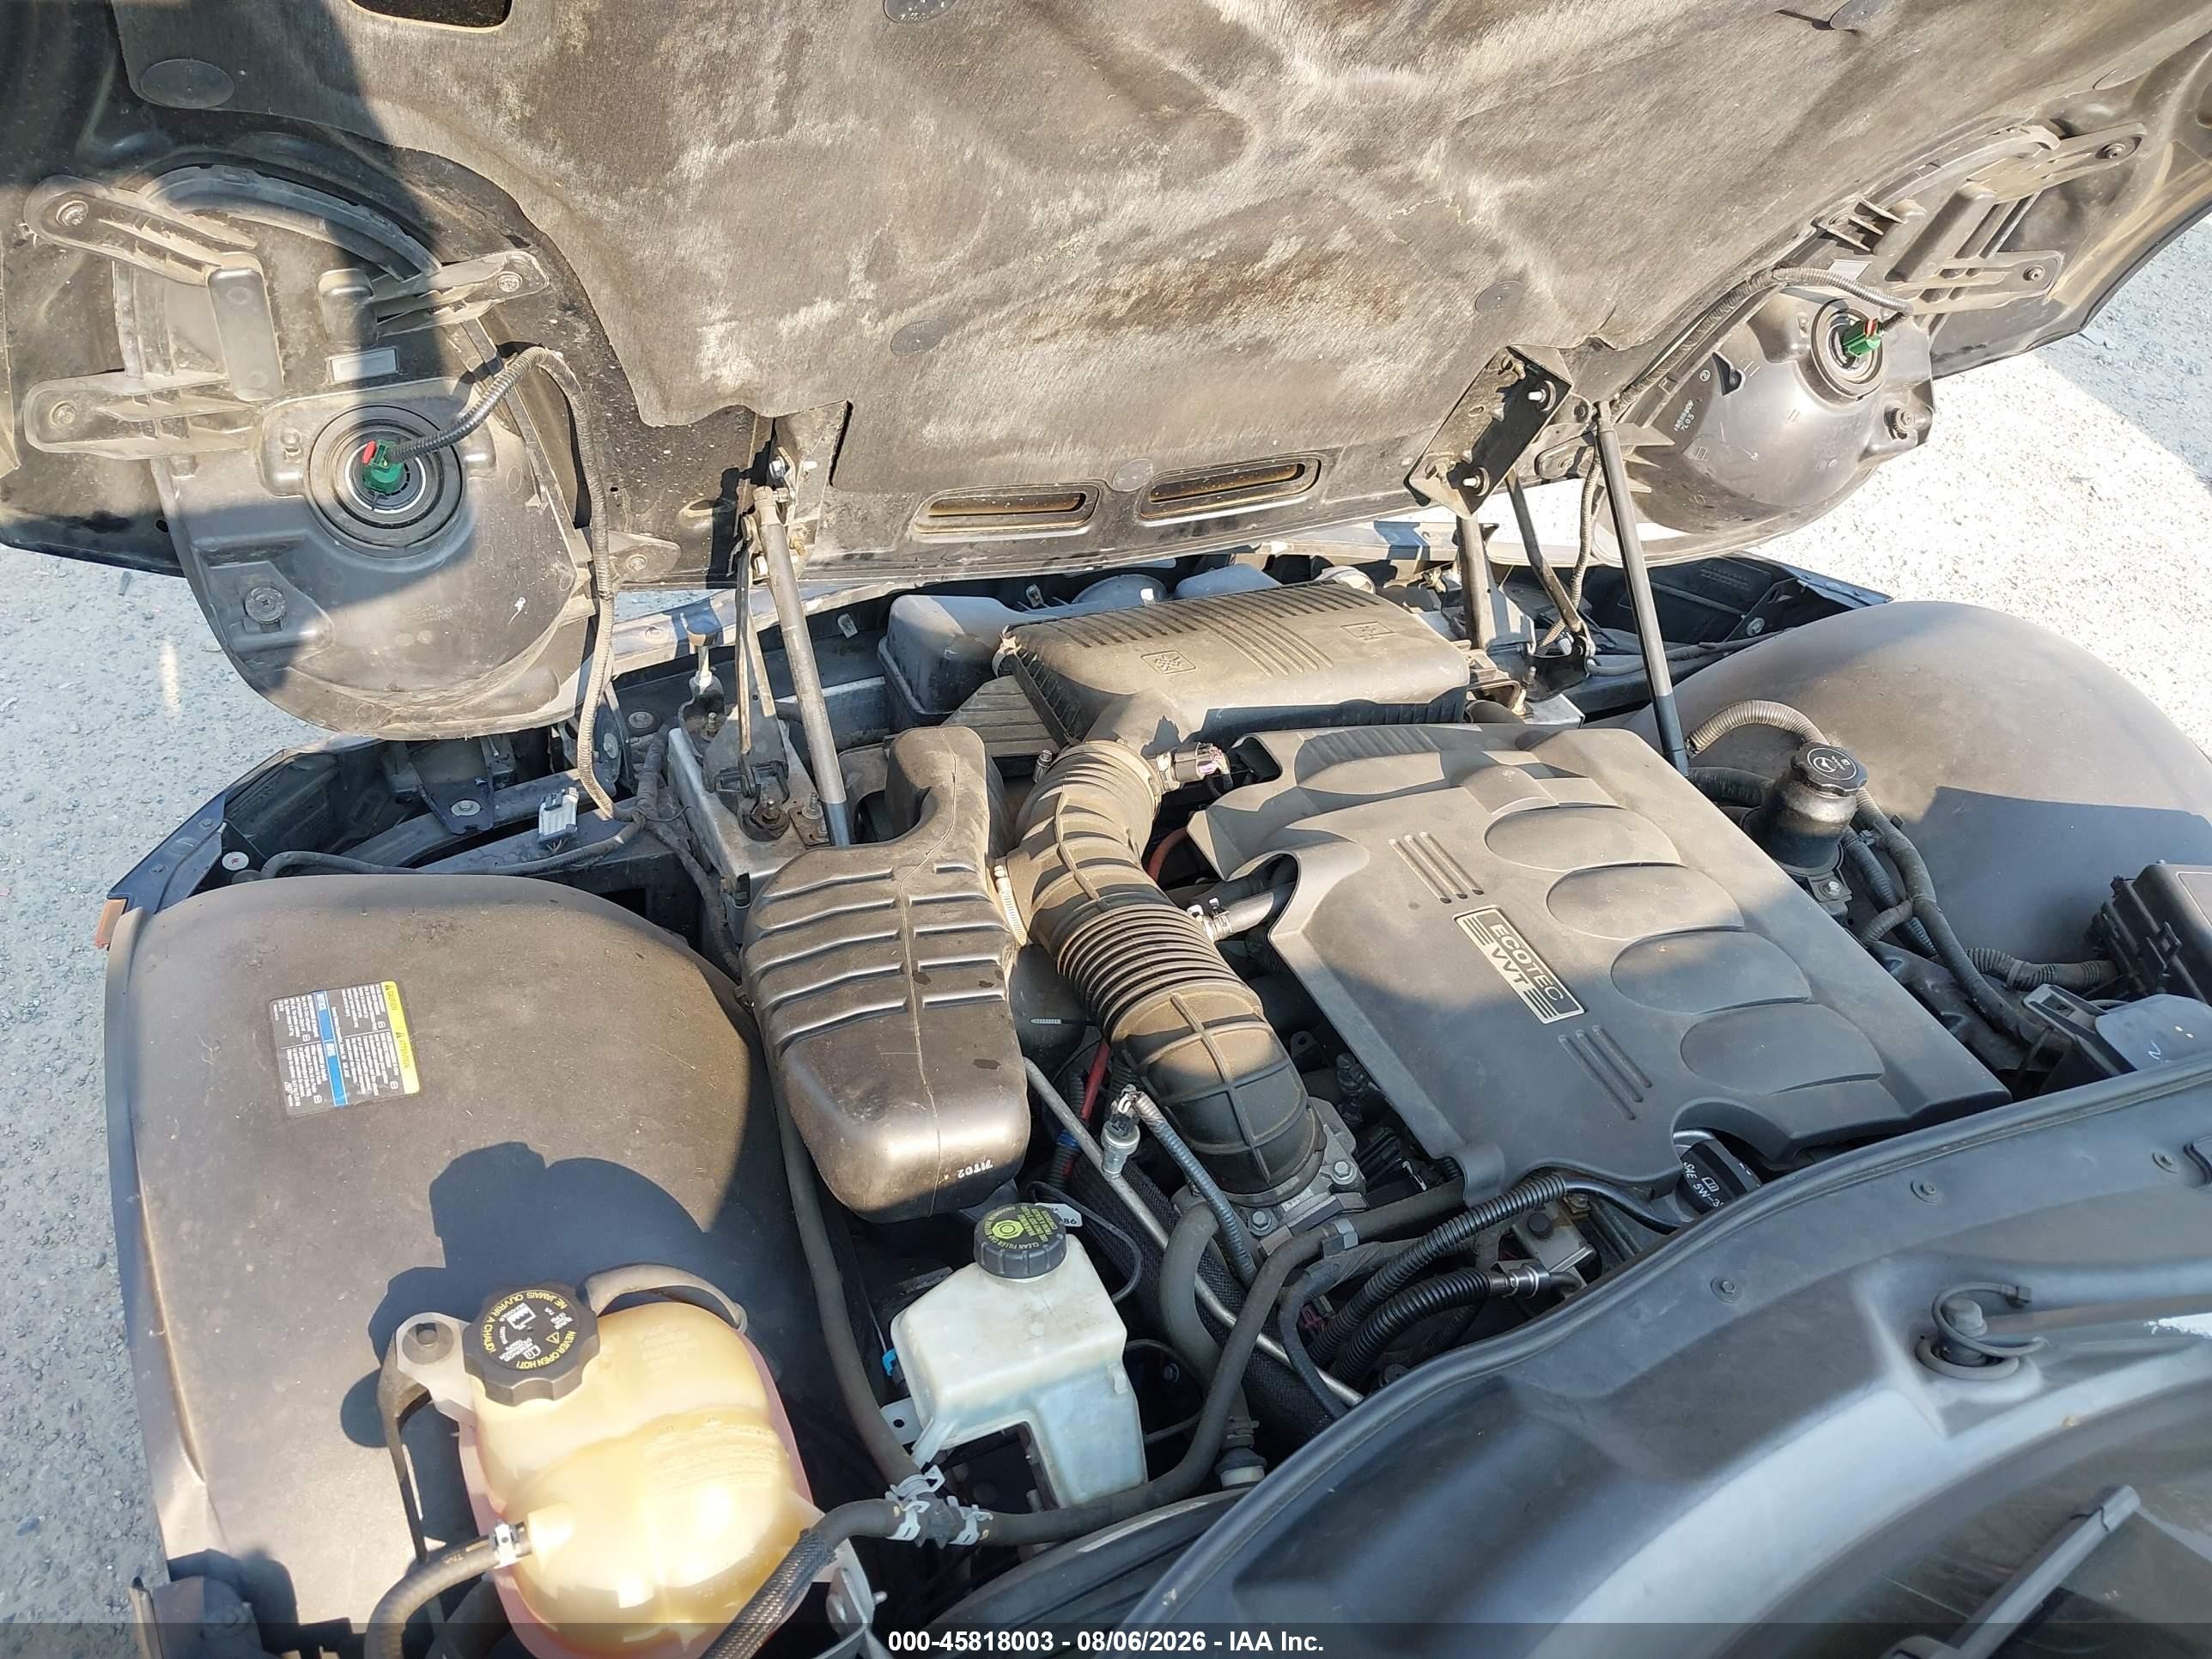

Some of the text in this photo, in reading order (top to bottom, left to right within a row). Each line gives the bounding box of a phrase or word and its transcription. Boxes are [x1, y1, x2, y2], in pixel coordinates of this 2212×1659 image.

[1490, 923, 1564, 1000] ECOTEC
[1492, 947, 1528, 984] VVT
[1683, 1162, 1724, 1207] SAE 5W-3
[997, 1238, 1018, 1250] FILLER
[1018, 1242, 1039, 1250] CLEAN
[490, 1294, 524, 1316] OUVRIR
[526, 1291, 557, 1302] JAMAIS
[555, 1297, 568, 1310] NE
[515, 1330, 578, 1370] NEVER OPEN HOT!
